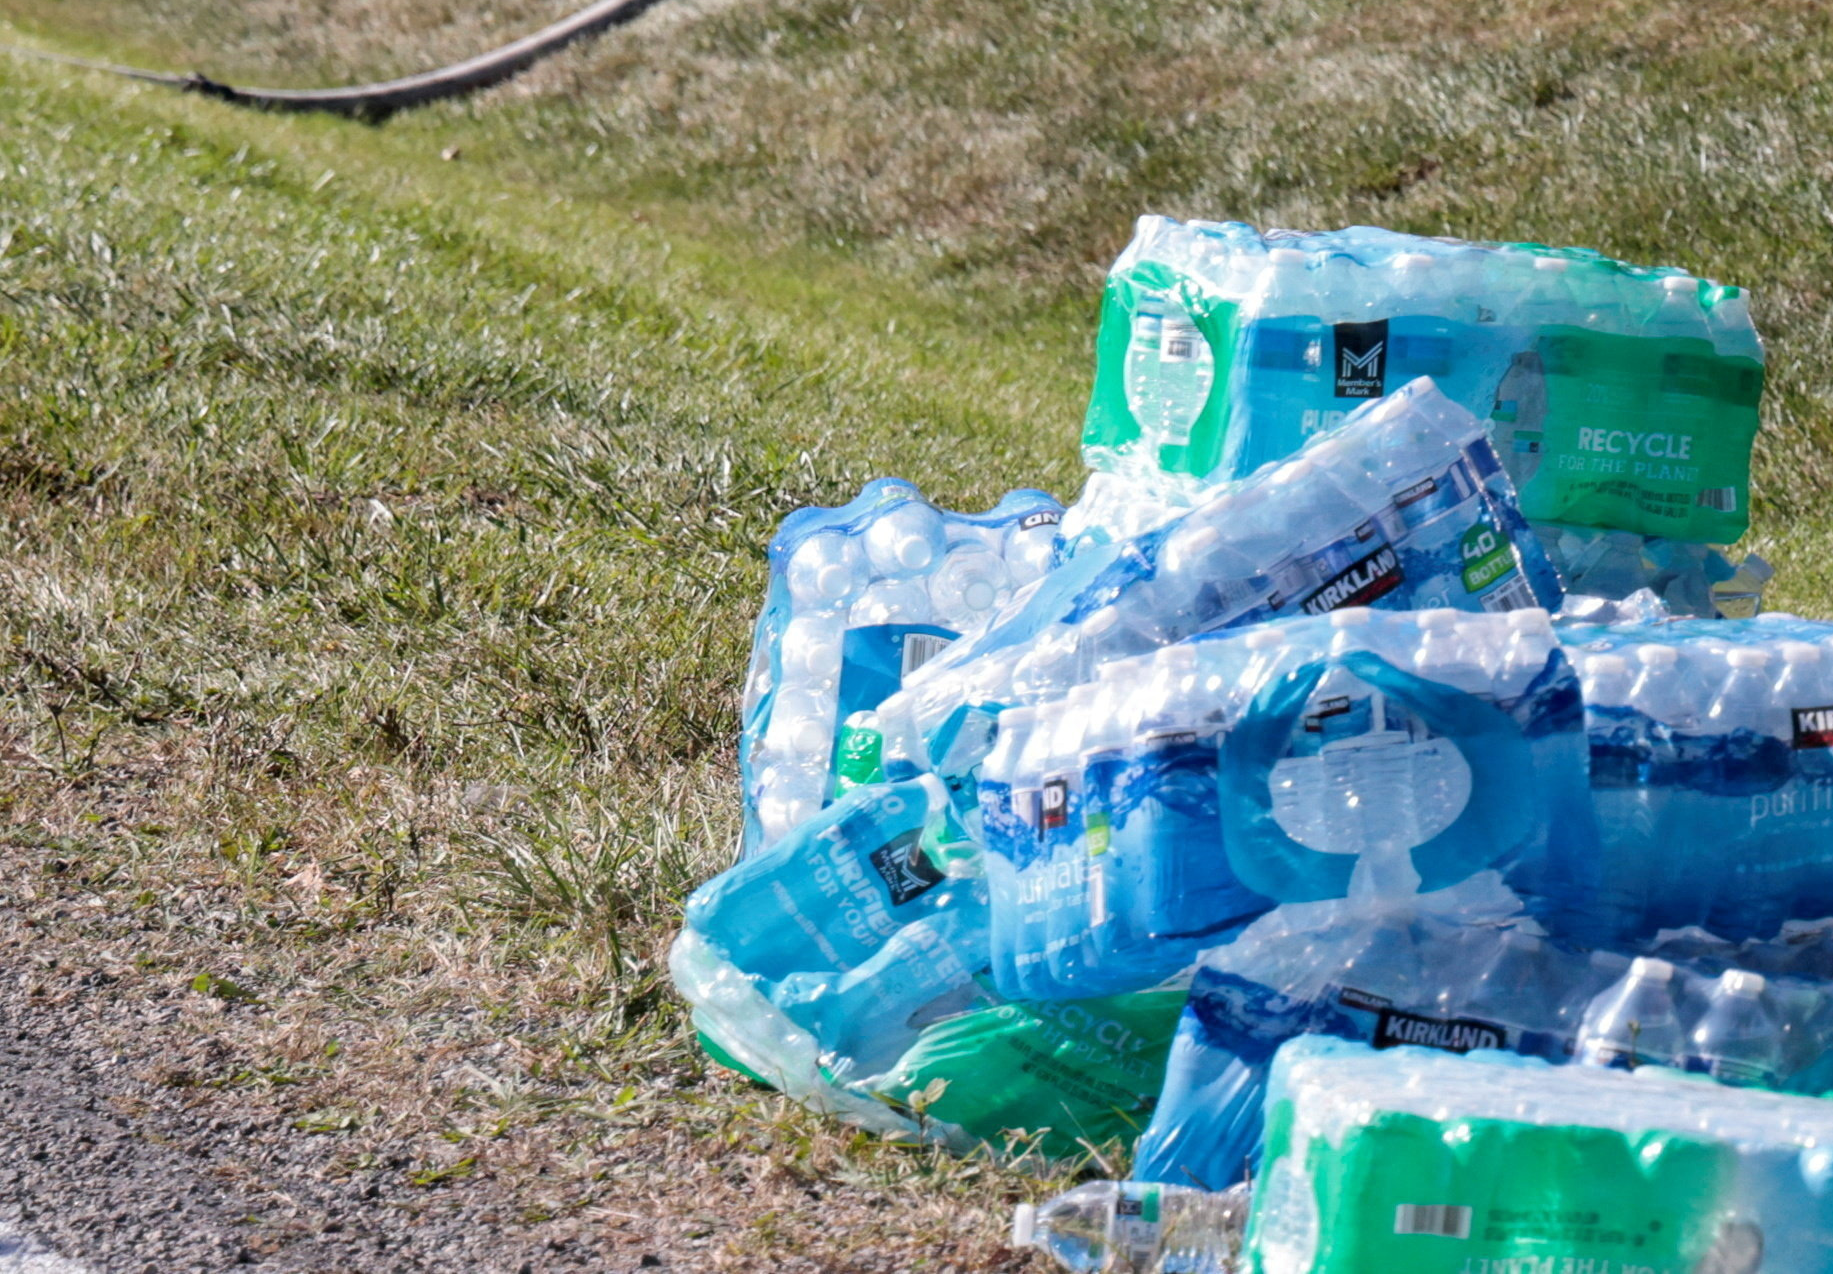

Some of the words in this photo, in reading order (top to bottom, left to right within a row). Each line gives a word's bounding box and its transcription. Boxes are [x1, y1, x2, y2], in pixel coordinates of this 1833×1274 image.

[1577, 425, 1693, 461] RECYCLE
[1558, 454, 1585, 471] FOR
[1590, 457, 1628, 473] THE
[1463, 530, 1497, 560] 40
[1385, 1014, 1500, 1051] KIRKLAND
